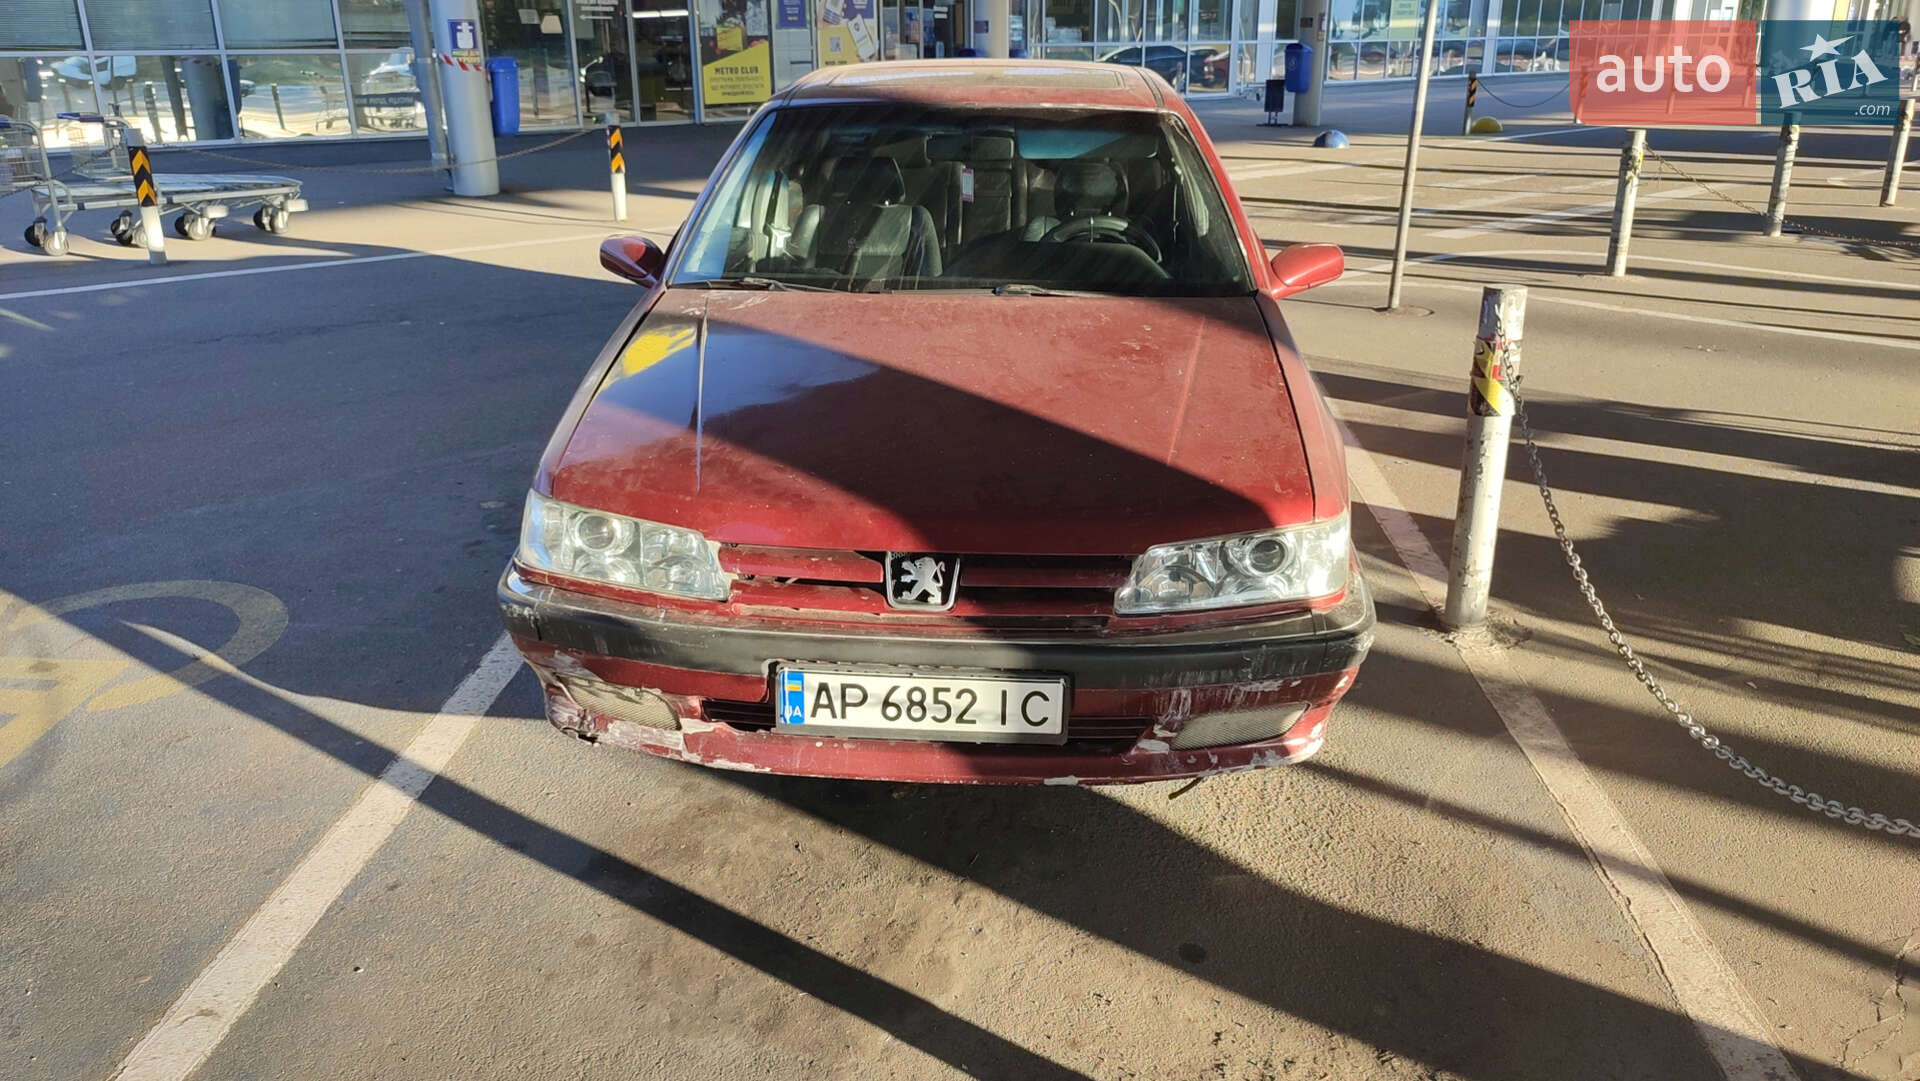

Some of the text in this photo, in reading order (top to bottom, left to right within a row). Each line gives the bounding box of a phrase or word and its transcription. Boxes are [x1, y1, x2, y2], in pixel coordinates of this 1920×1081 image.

[714, 66, 759, 75] METRO CLUB
[810, 682, 869, 719] AP
[881, 685, 978, 725] 6852
